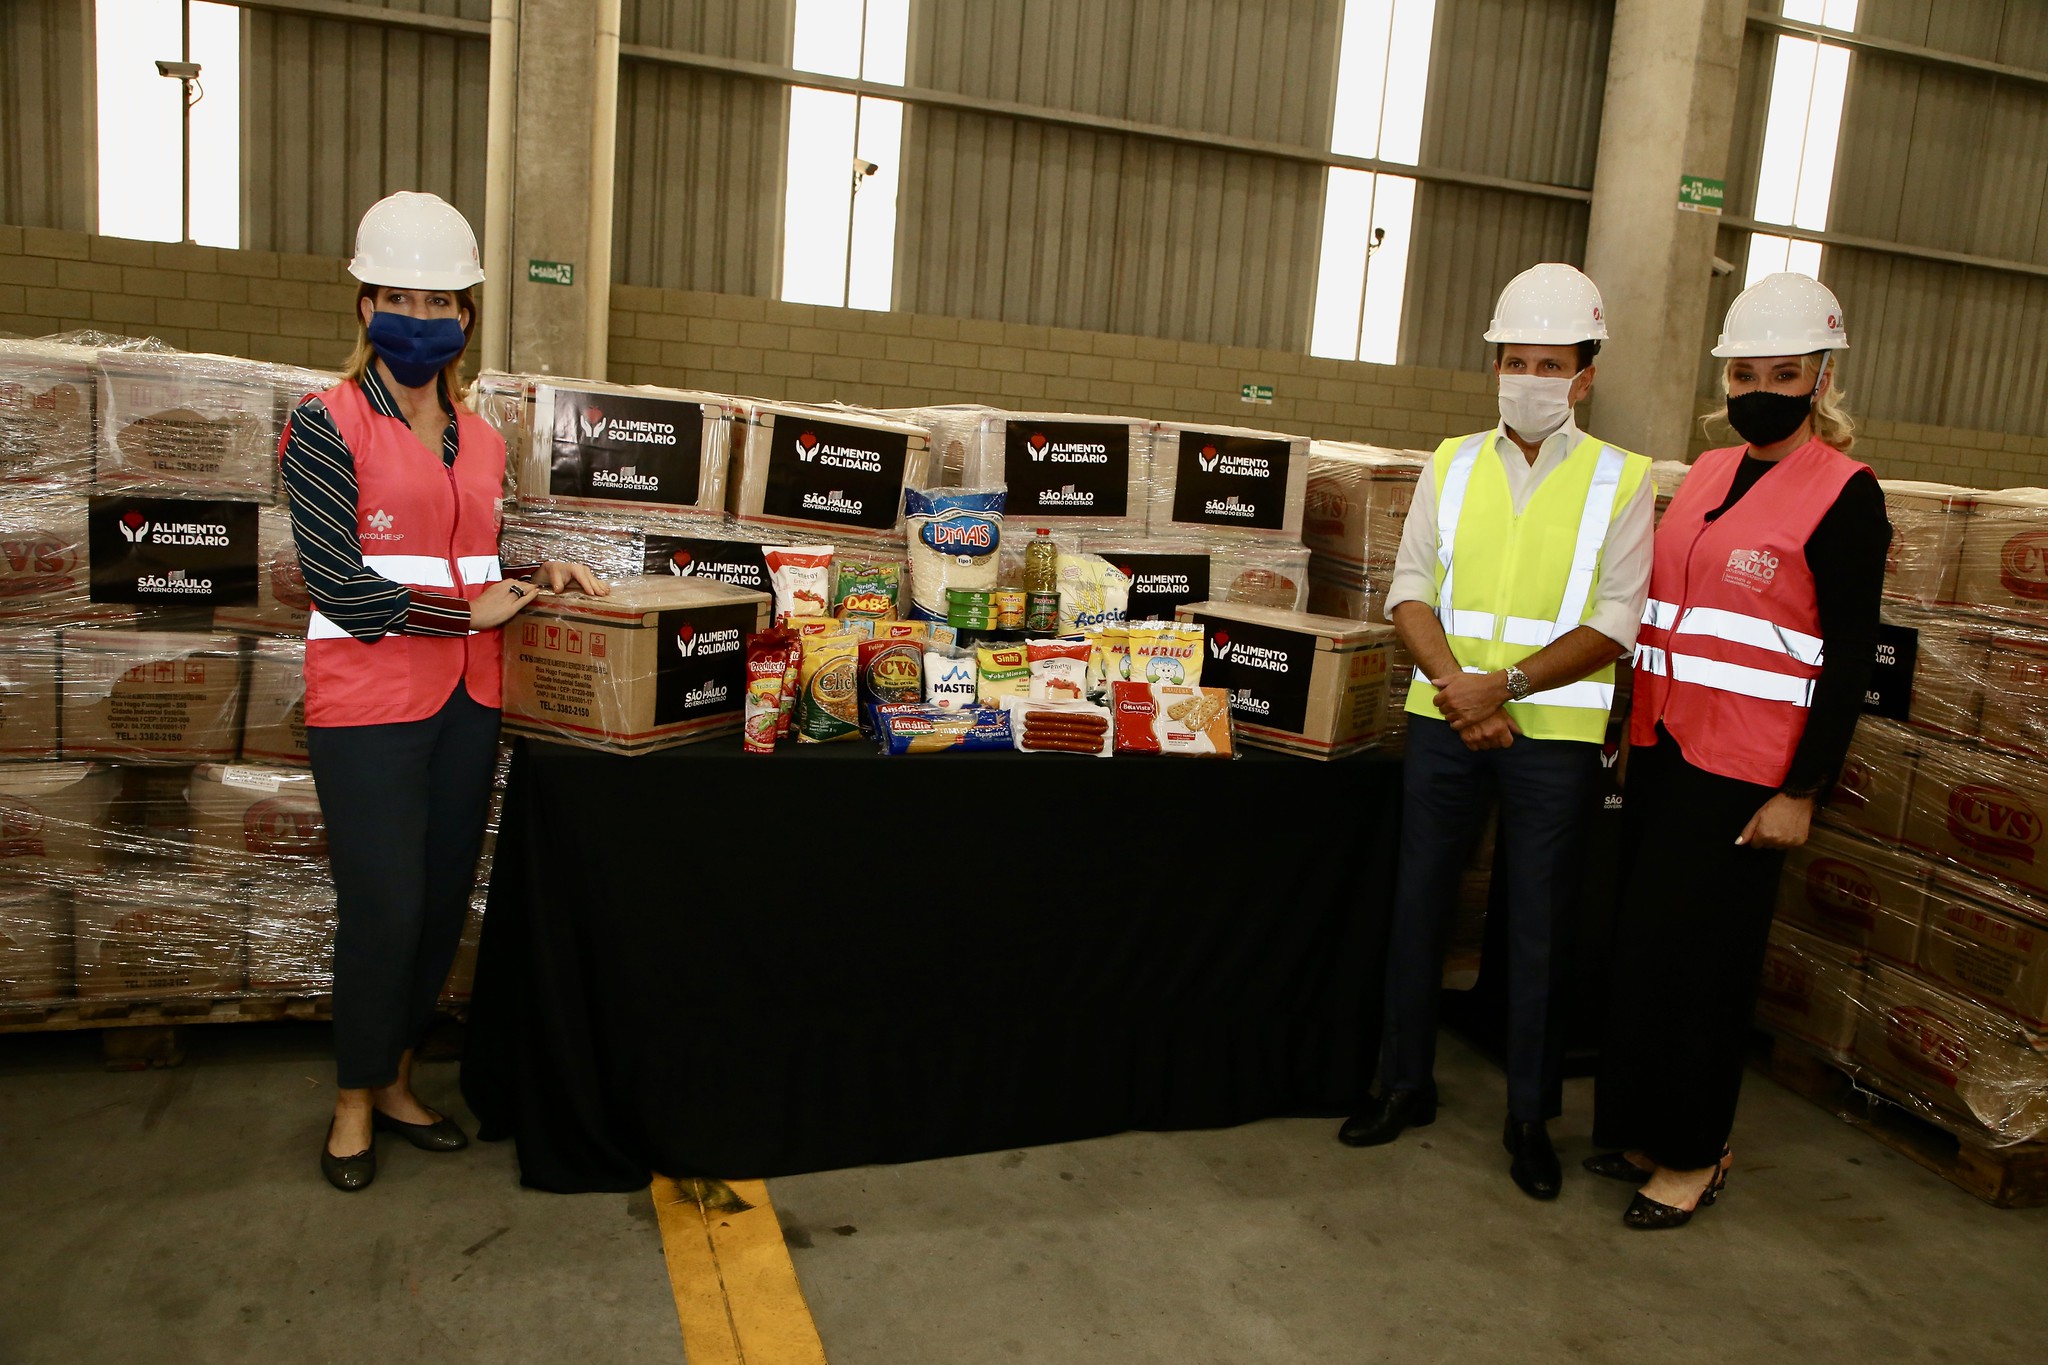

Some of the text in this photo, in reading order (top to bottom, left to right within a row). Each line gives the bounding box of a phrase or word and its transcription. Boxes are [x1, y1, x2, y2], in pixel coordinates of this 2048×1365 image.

[609, 419, 674, 434] ALIMENTO
[608, 431, 676, 445] SOLIDÁRIO
[821, 445, 880, 461] ALIMENTO
[1051, 443, 1105, 453] ALIMENTO
[820, 456, 881, 472] SOLIDÁRIO
[1051, 453, 1107, 463] SOLIDÁRIO
[1220, 456, 1268, 468] ALIMENTO
[593, 470, 658, 485] SÃO PAULO
[1220, 466, 1269, 477] SOLIDÁRIO
[803, 493, 862, 509] SÃO PAULO
[1039, 490, 1093, 500] SÃO PAULO
[802, 503, 830, 511] GOVERNO
[1205, 499, 1255, 512] SÃO PAULO
[153, 522, 226, 535] ALIMENTO
[153, 533, 229, 546] SOLIDÁRIO
[0, 541, 65, 572] VS
[1749, 550, 1779, 569] SÃO
[697, 562, 759, 574] ALIMENTO
[1727, 559, 1774, 580] PAULO
[138, 575, 212, 588] SÃO PAULO
[1137, 575, 1188, 584] ALIMENTO
[1136, 583, 1190, 593] SOLIDÁRIO
[698, 629, 739, 643] ALIMENTO
[697, 640, 740, 655] SOLIDÁRIO
[1137, 644, 1195, 658] MERILÚ
[1232, 643, 1287, 661] ALIMENTO
[881, 661, 917, 677] CVS
[1231, 654, 1288, 672] SOLIDÁRIO
[685, 686, 727, 702] SÃO PAULO
[934, 684, 975, 693] MASTER
[540, 700, 590, 717] TEL.: 3382-2150
[1237, 698, 1270, 709] PAULO
[1248, 706, 1269, 715] ESTADO
[893, 720, 932, 730] Amália
[116, 732, 182, 741] TEL.: 3382-2150
[1605, 794, 1622, 805] SÃO
[1959, 795, 2033, 840] CVS
[259, 812, 323, 838] CV
